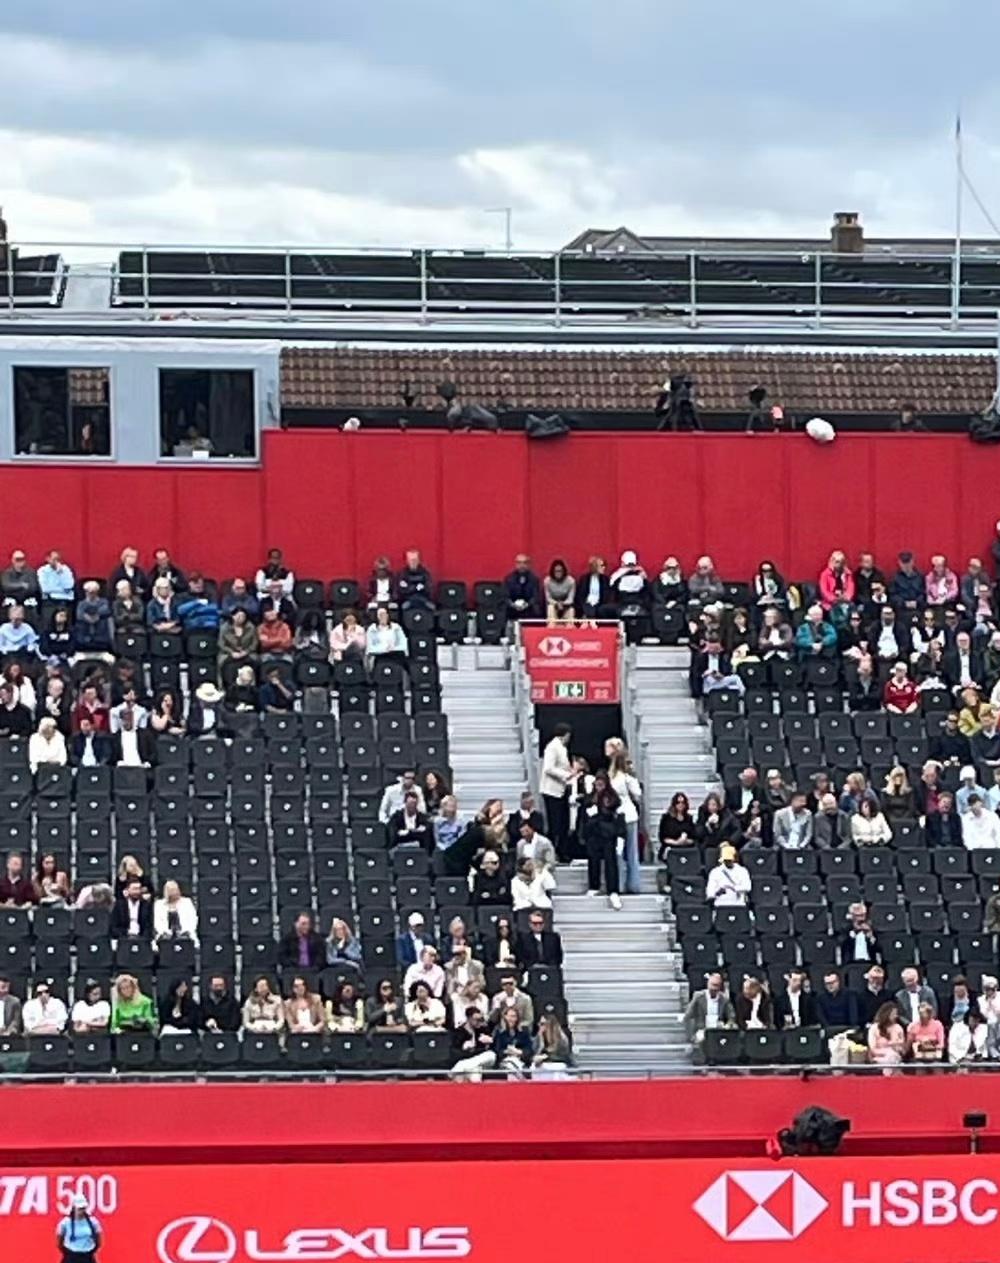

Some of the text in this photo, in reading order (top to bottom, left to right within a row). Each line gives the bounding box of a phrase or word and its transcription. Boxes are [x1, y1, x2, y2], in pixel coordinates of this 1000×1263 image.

[0, 1173, 117, 1215] TA 500
[841, 1178, 999, 1228] HSBC
[243, 1226, 472, 1260] LEXUS
